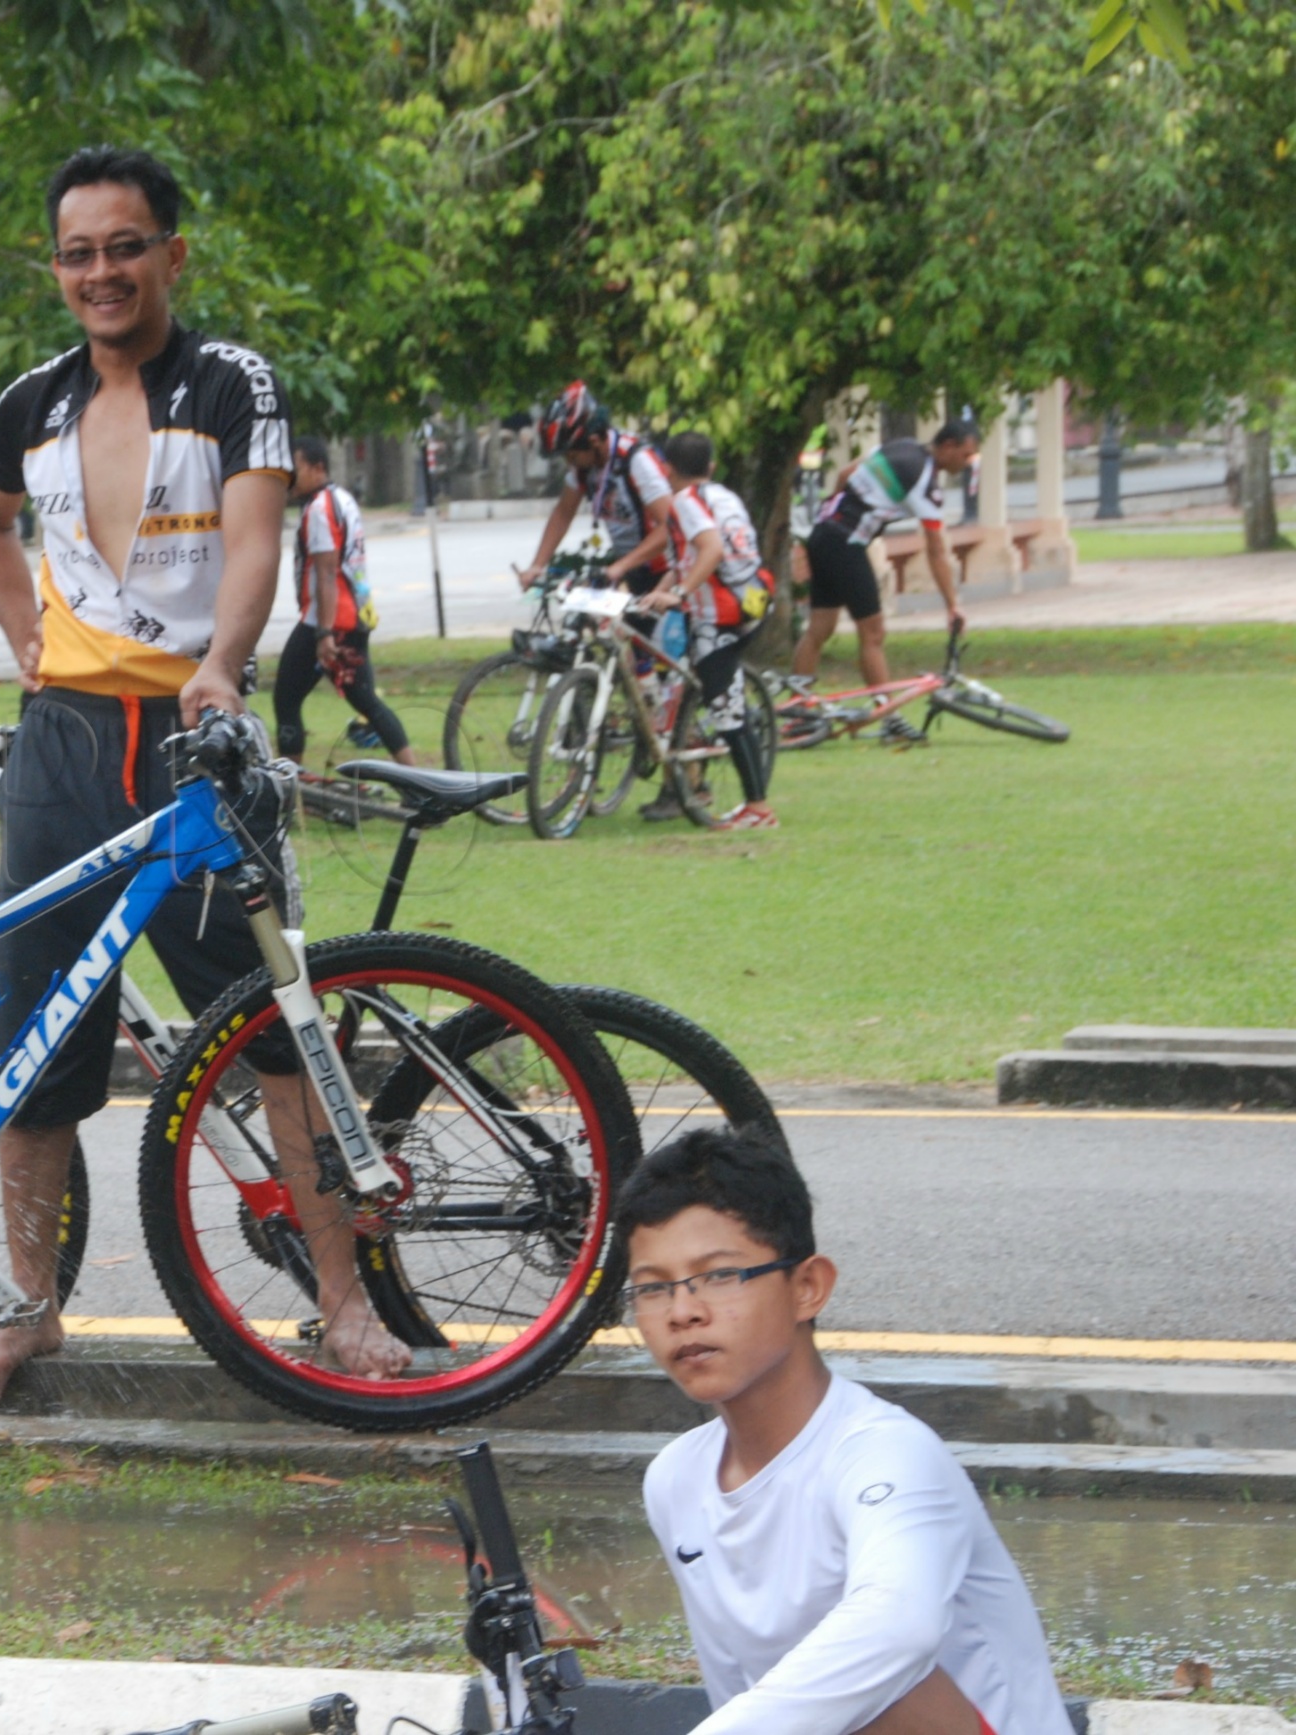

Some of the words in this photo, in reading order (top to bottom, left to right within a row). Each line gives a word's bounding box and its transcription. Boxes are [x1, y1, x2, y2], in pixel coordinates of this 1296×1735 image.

[199, 341, 278, 414] adidas
[144, 516, 222, 534] STRONG
[165, 1012, 247, 1145] MAXXIS
[300, 1022, 370, 1161] EPICON
